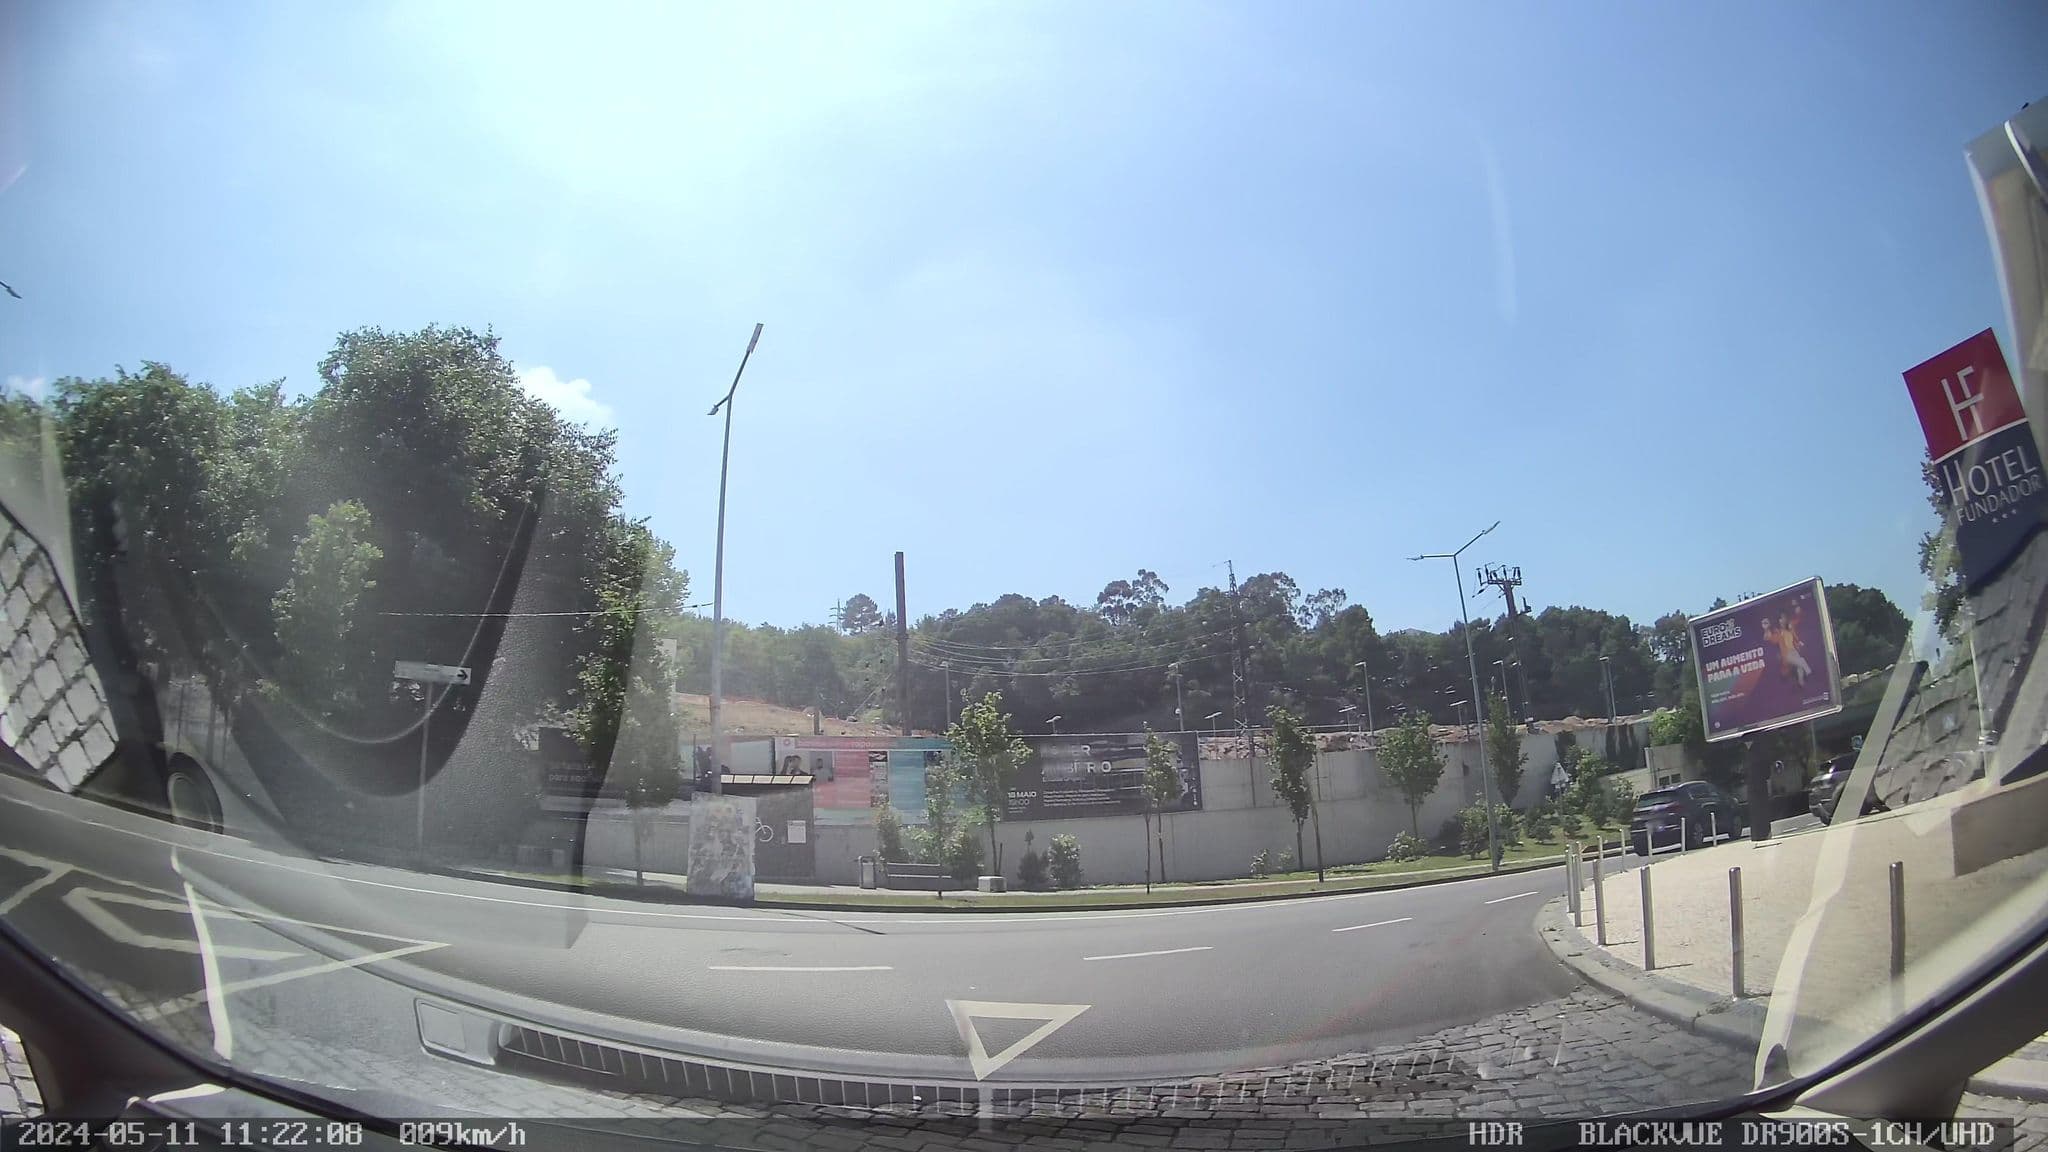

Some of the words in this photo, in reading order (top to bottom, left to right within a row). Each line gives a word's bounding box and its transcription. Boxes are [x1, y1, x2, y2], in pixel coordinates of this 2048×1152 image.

[1943, 445, 2038, 507] HOTEL
[1955, 474, 2043, 527] FUNDADOR
[1701, 623, 1727, 638] EURO
[1702, 626, 1742, 648] DREAMS
[1705, 660, 1720, 673] UM
[1720, 647, 1765, 669] AUMENTO
[1707, 668, 1733, 684] PARA
[1732, 665, 1741, 677] A
[1740, 658, 1766, 675] VIDA
[1016, 790, 1037, 798] MAIO
